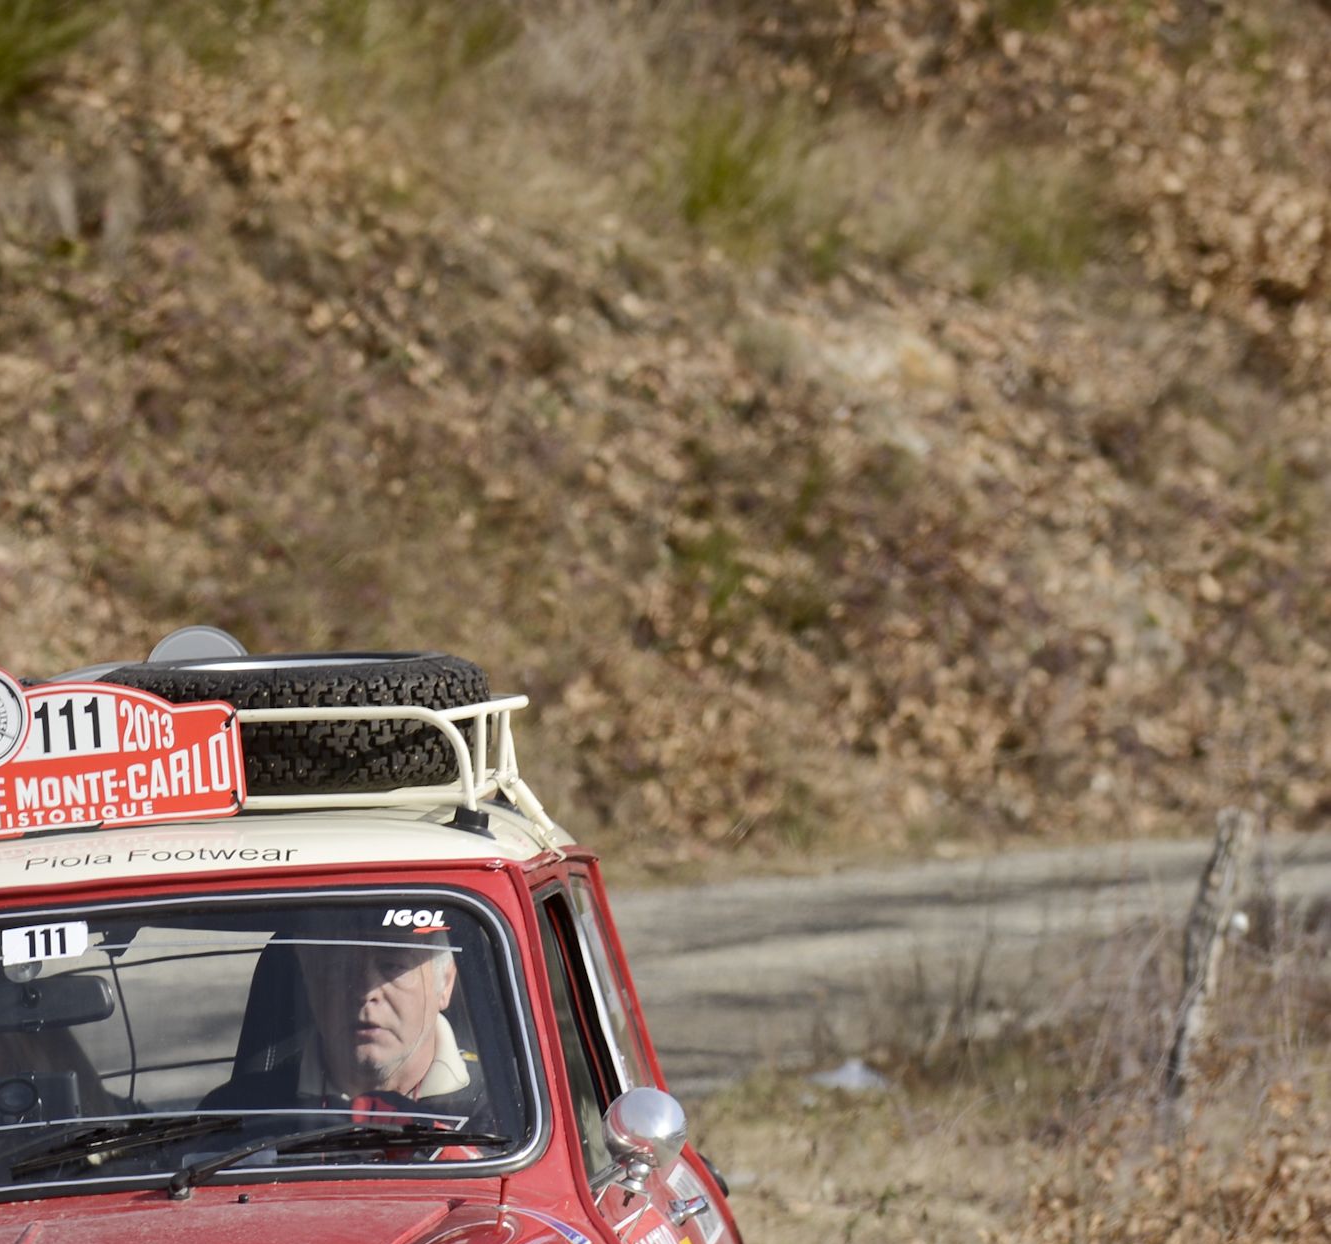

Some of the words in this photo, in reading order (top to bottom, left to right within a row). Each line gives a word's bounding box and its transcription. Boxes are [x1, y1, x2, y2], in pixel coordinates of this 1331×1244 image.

[34, 697, 103, 754] 111
[120, 700, 174, 753] 2013
[15, 732, 230, 810] MONTE-CARLO
[24, 853, 113, 870] Piola
[128, 845, 299, 863] Footwear
[382, 909, 446, 928] IGOL
[24, 927, 68, 958] 111
